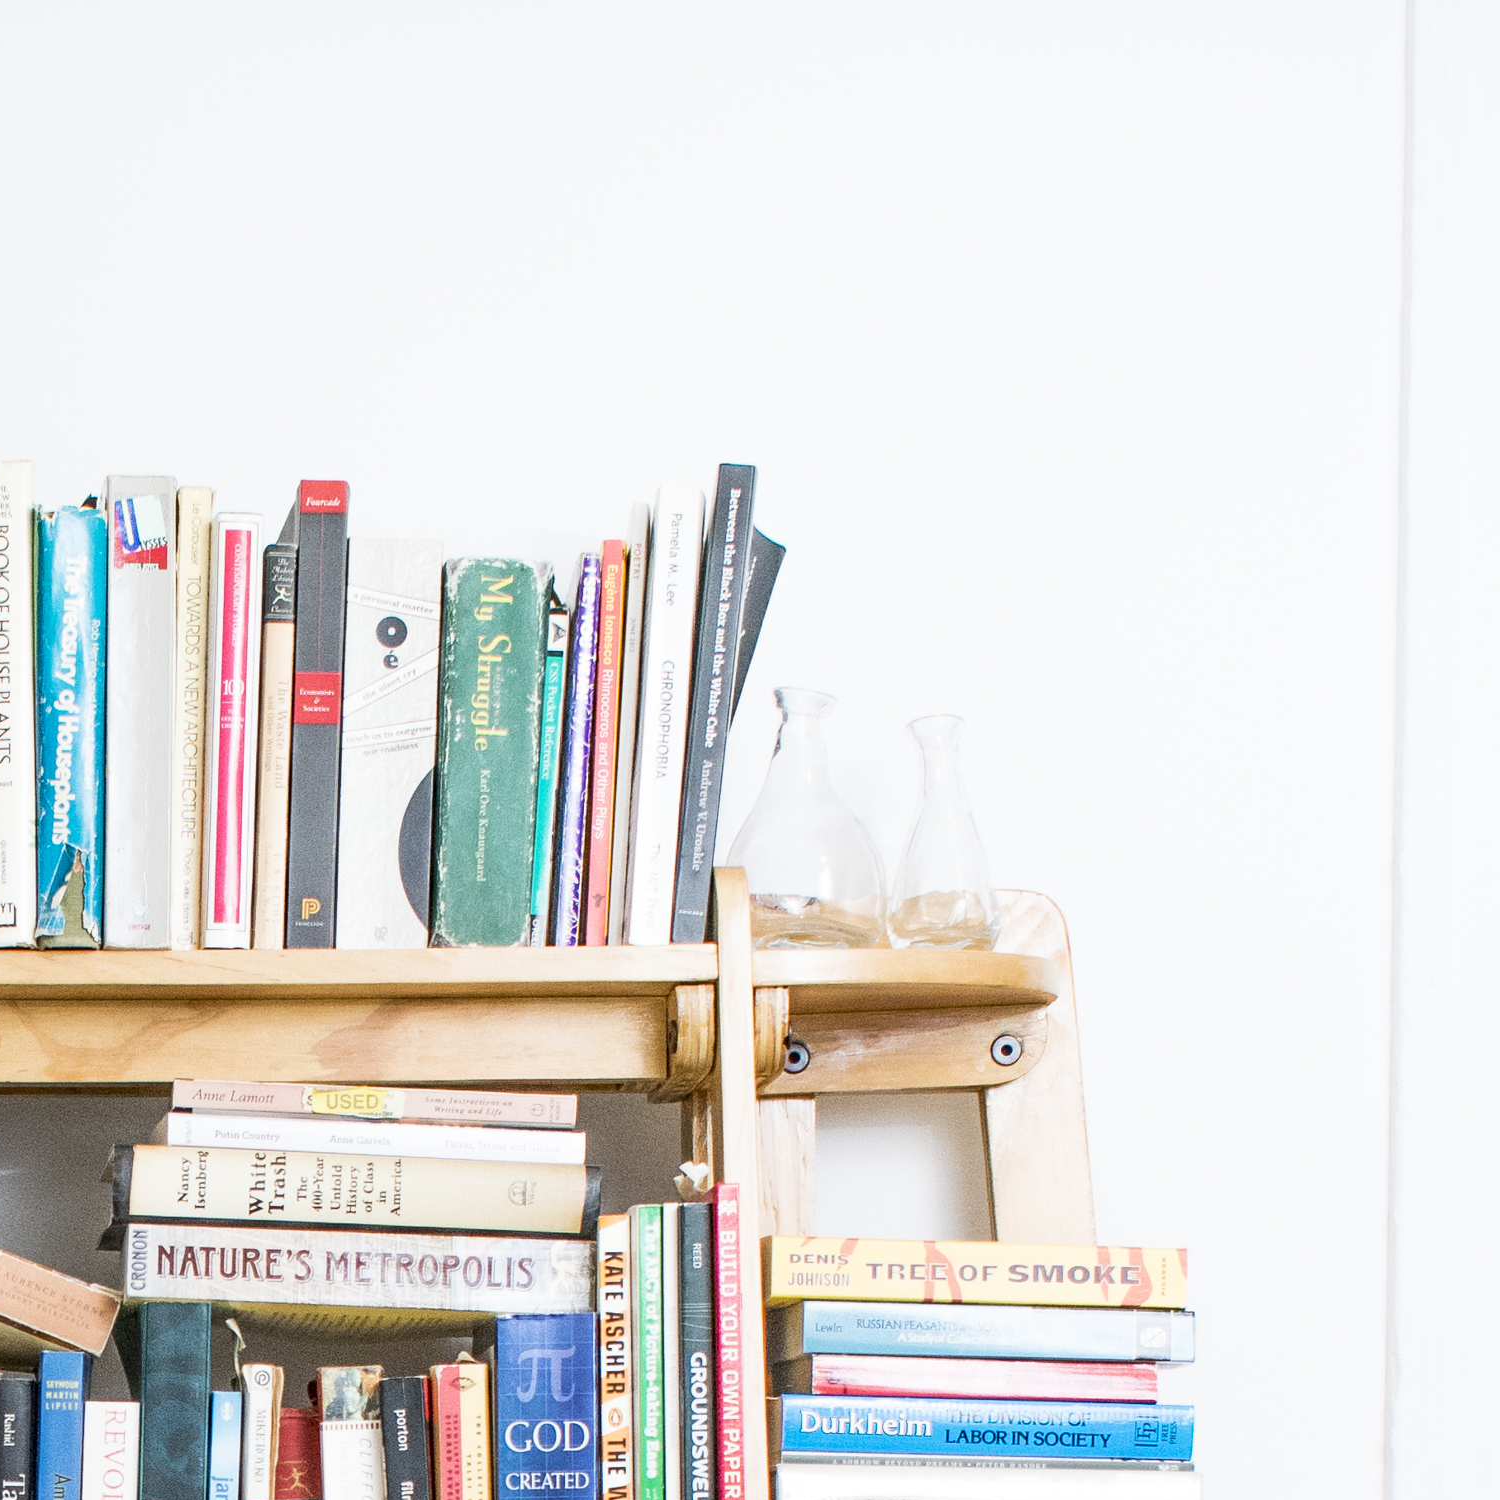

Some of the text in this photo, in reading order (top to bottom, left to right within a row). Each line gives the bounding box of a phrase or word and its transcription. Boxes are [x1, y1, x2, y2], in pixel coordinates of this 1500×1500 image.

[471, 574, 514, 752] My Struggle
[656, 660, 674, 780] CHRONOPHOBIA
[326, 1093, 378, 1109] USED
[132, 1230, 149, 1290] CRONON
[157, 1246, 536, 1292] NATURE'S METROPOLIS
[789, 1254, 849, 1265] DENIS
[788, 1272, 849, 1287] JOHNSON
[866, 1263, 1141, 1285] TREE OF SMOKE
[800, 1411, 932, 1437] Durkheim
[505, 1422, 590, 1452] GOD
[945, 1430, 1112, 1447] LABOR IN SOCIETY
[505, 1472, 589, 1489] CREATED
